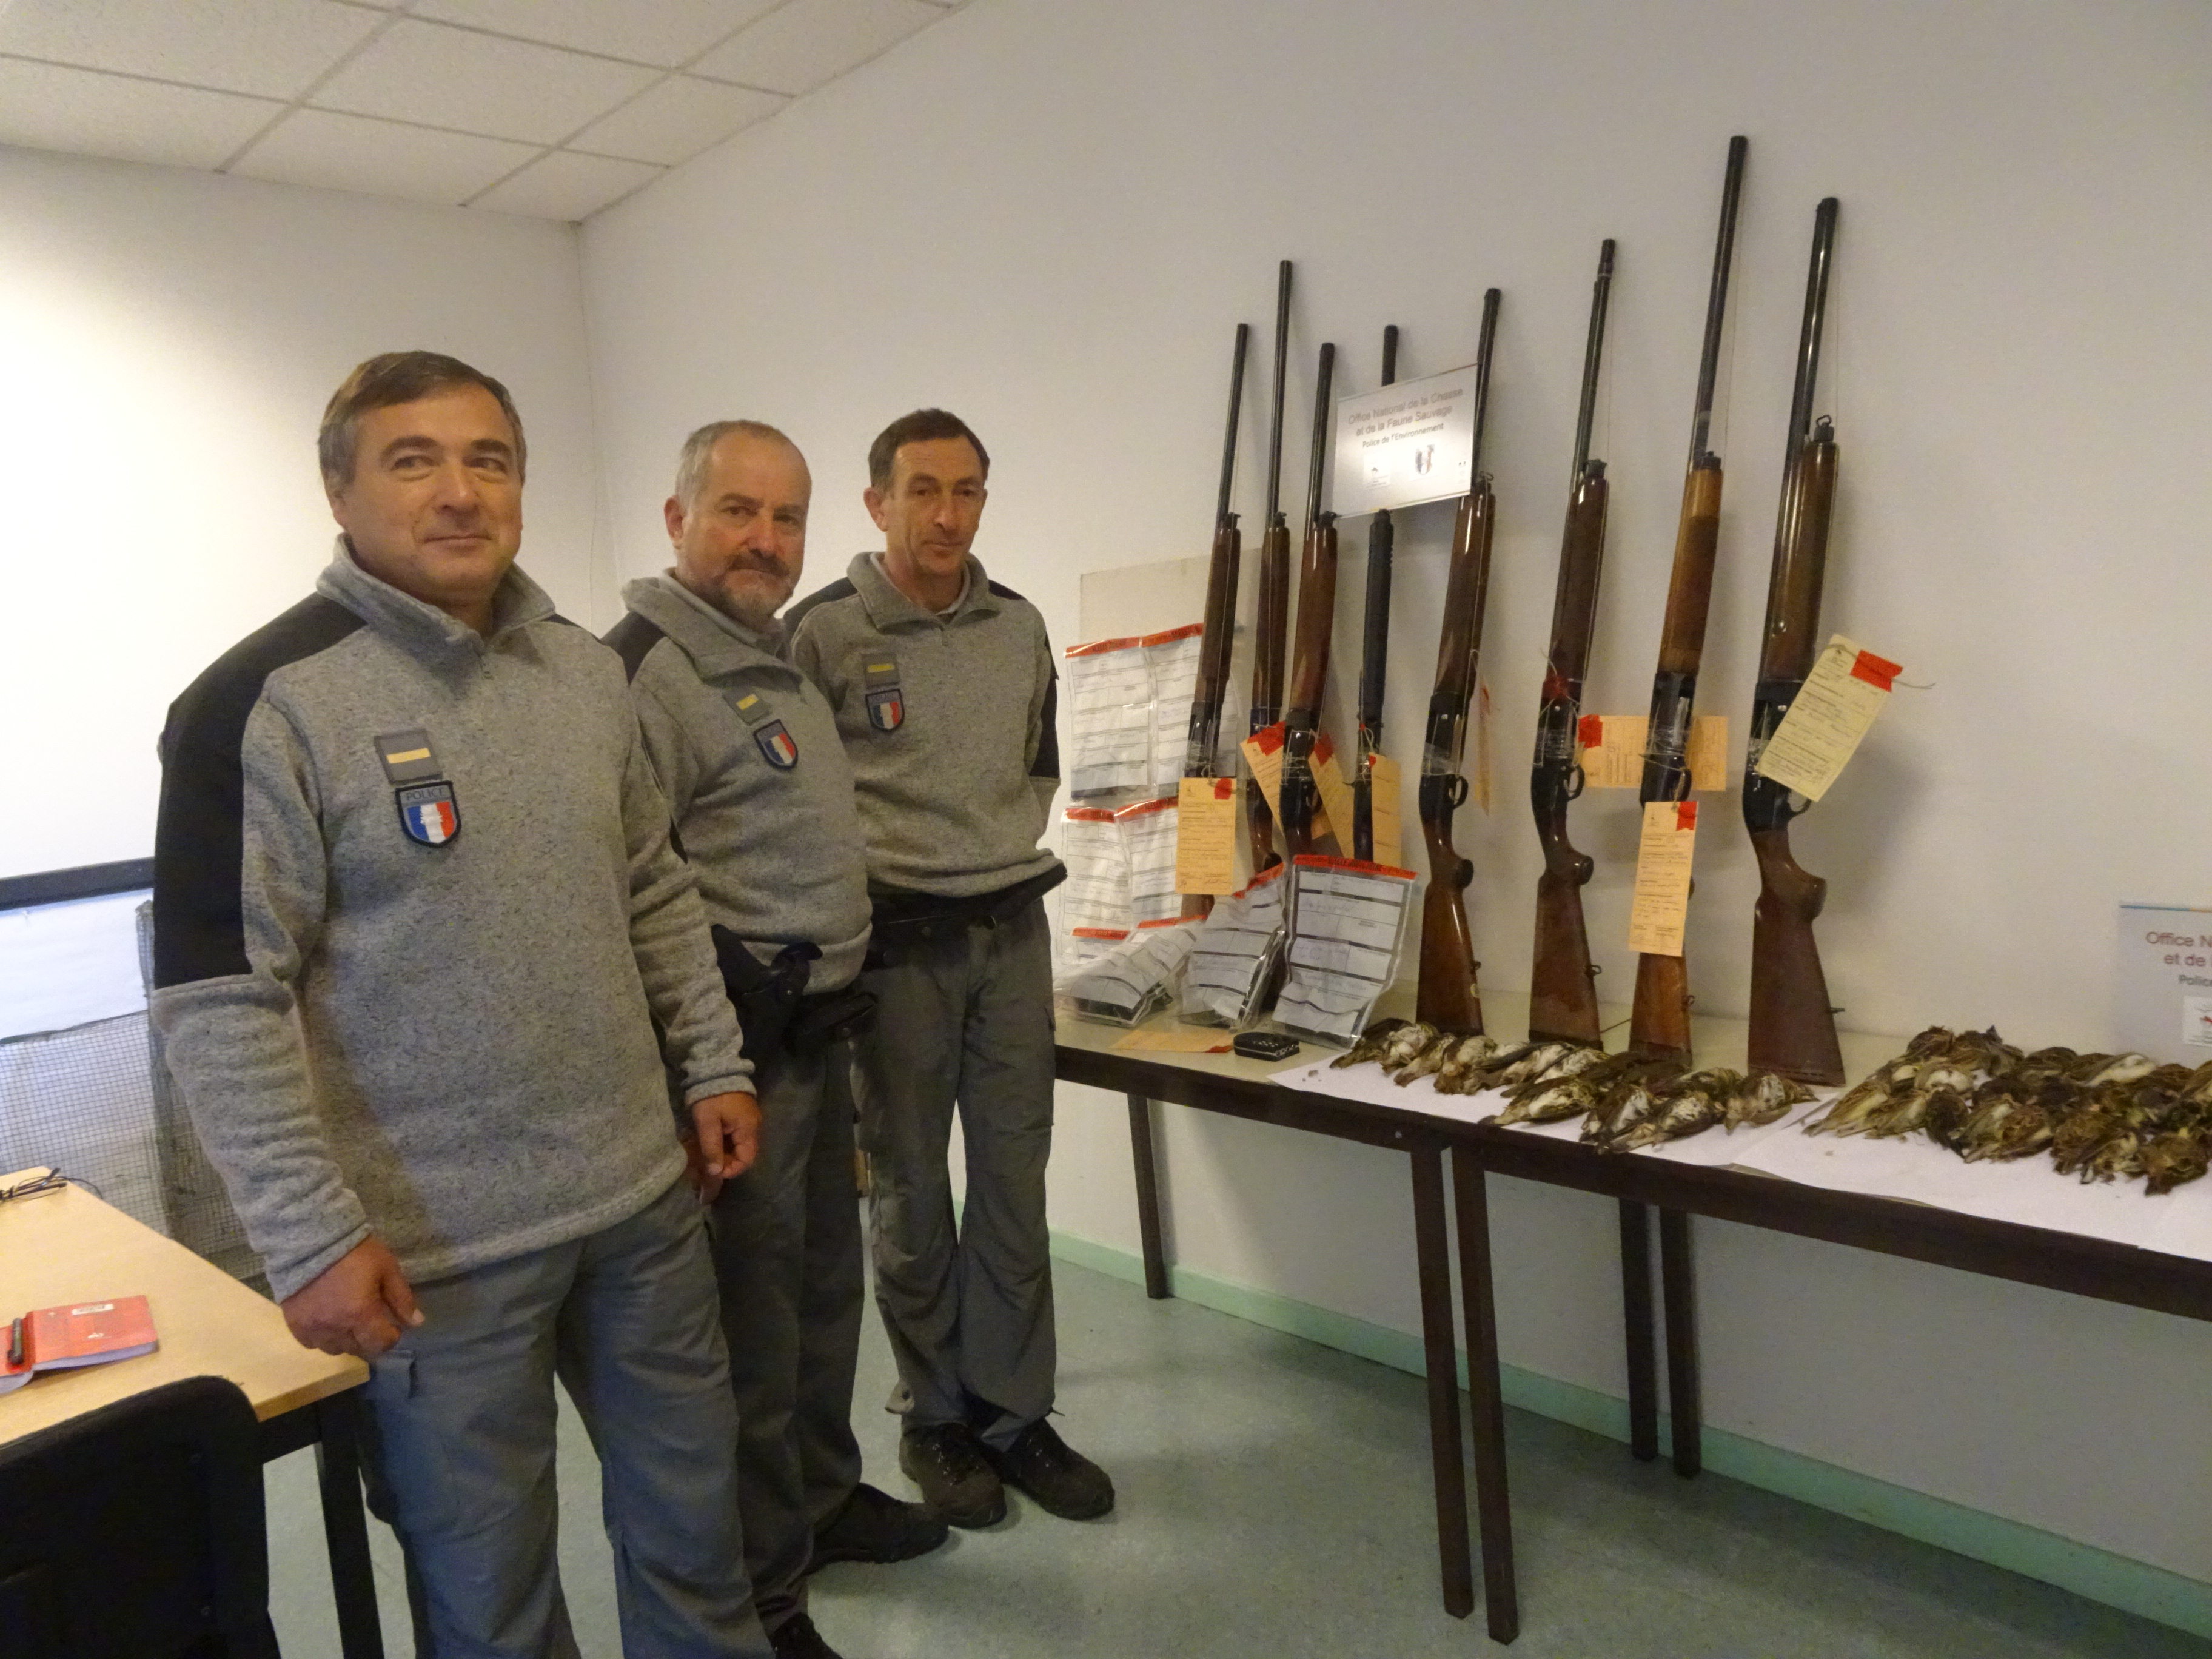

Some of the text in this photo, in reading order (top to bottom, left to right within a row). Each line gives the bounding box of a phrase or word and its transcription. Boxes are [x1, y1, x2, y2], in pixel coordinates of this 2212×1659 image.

[1349, 413, 1370, 424] Office
[1356, 426, 1364, 436] et
[1366, 424, 1376, 434] de
[1387, 415, 1413, 428] Faune
[1362, 439, 1380, 448] Police
[406, 788, 446, 801] POLICE
[2146, 931, 2194, 947] Office
[2164, 953, 2180, 965] et
[2185, 954, 2206, 967] de
